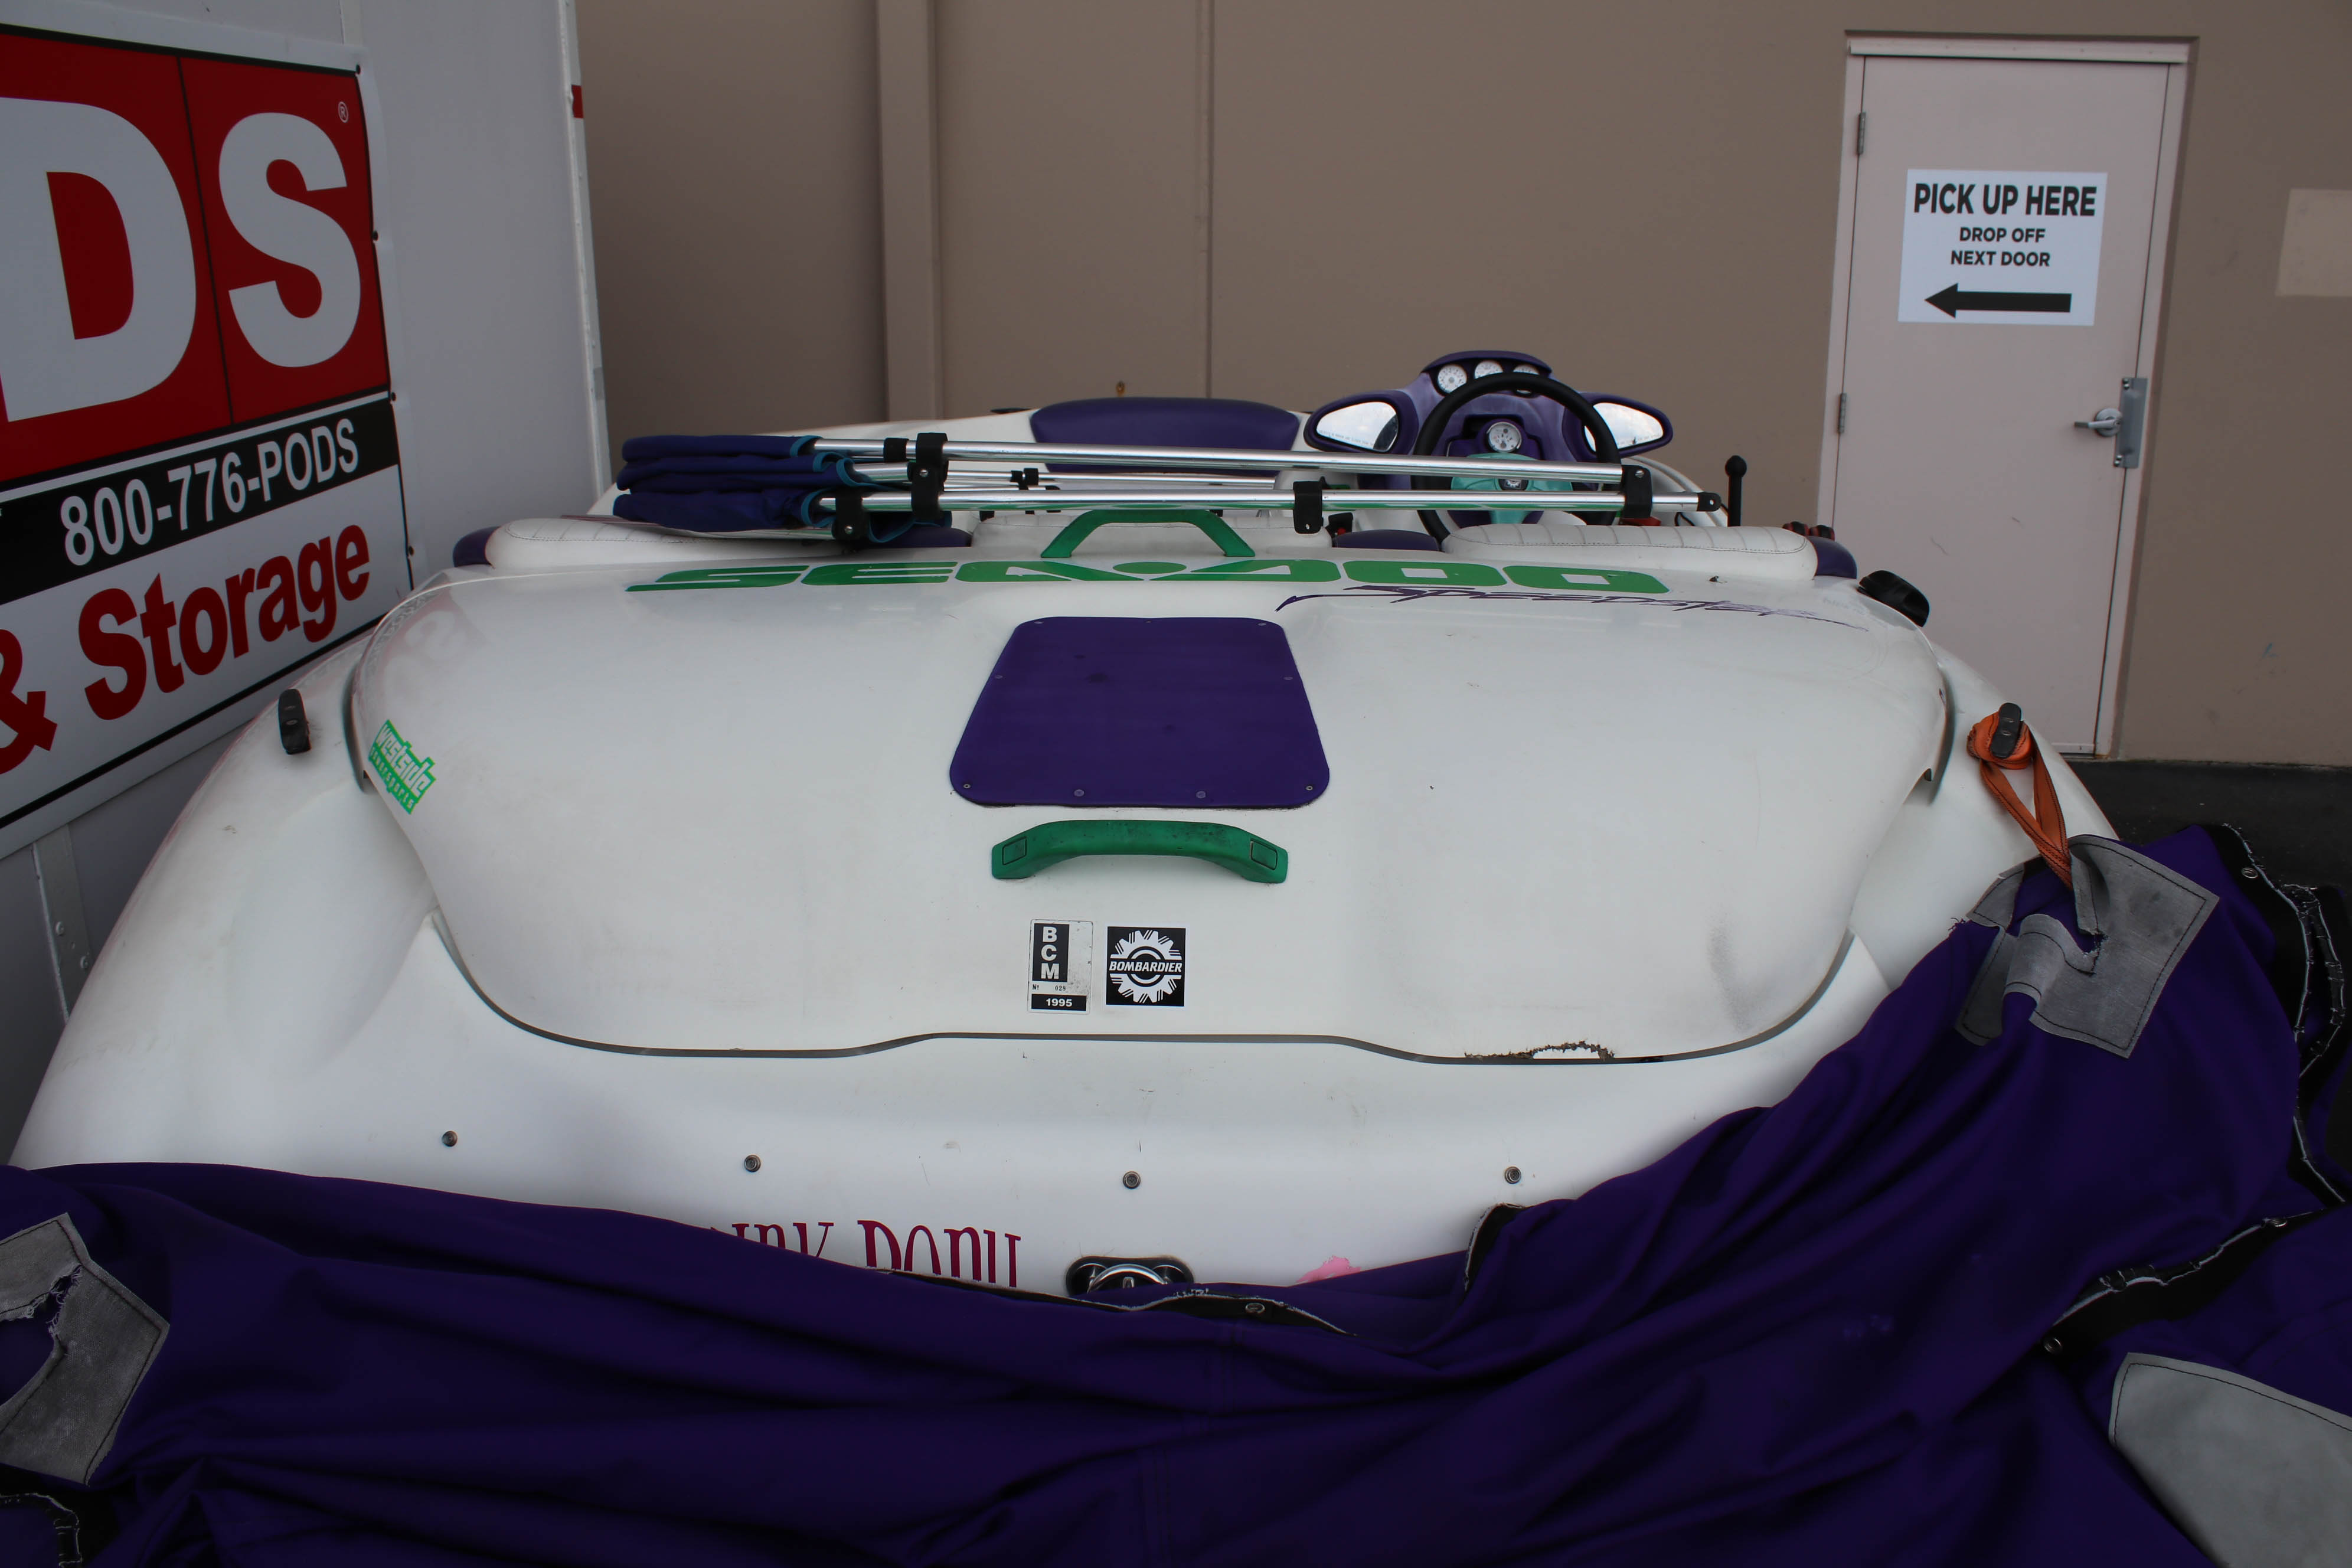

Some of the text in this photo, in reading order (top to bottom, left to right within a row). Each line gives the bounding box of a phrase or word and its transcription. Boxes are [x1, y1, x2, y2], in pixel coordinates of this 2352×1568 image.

[1913, 183, 2098, 216] PICK UP HERE
[1959, 227, 2046, 243] DROP OFF
[1951, 250, 2051, 267] NEXT DOOR
[60, 418, 359, 566] 800-776-PODS
[78, 524, 371, 721] Storage
[1109, 961, 1183, 973] BOMBARDIER
[1046, 998, 1073, 1007] 1995
